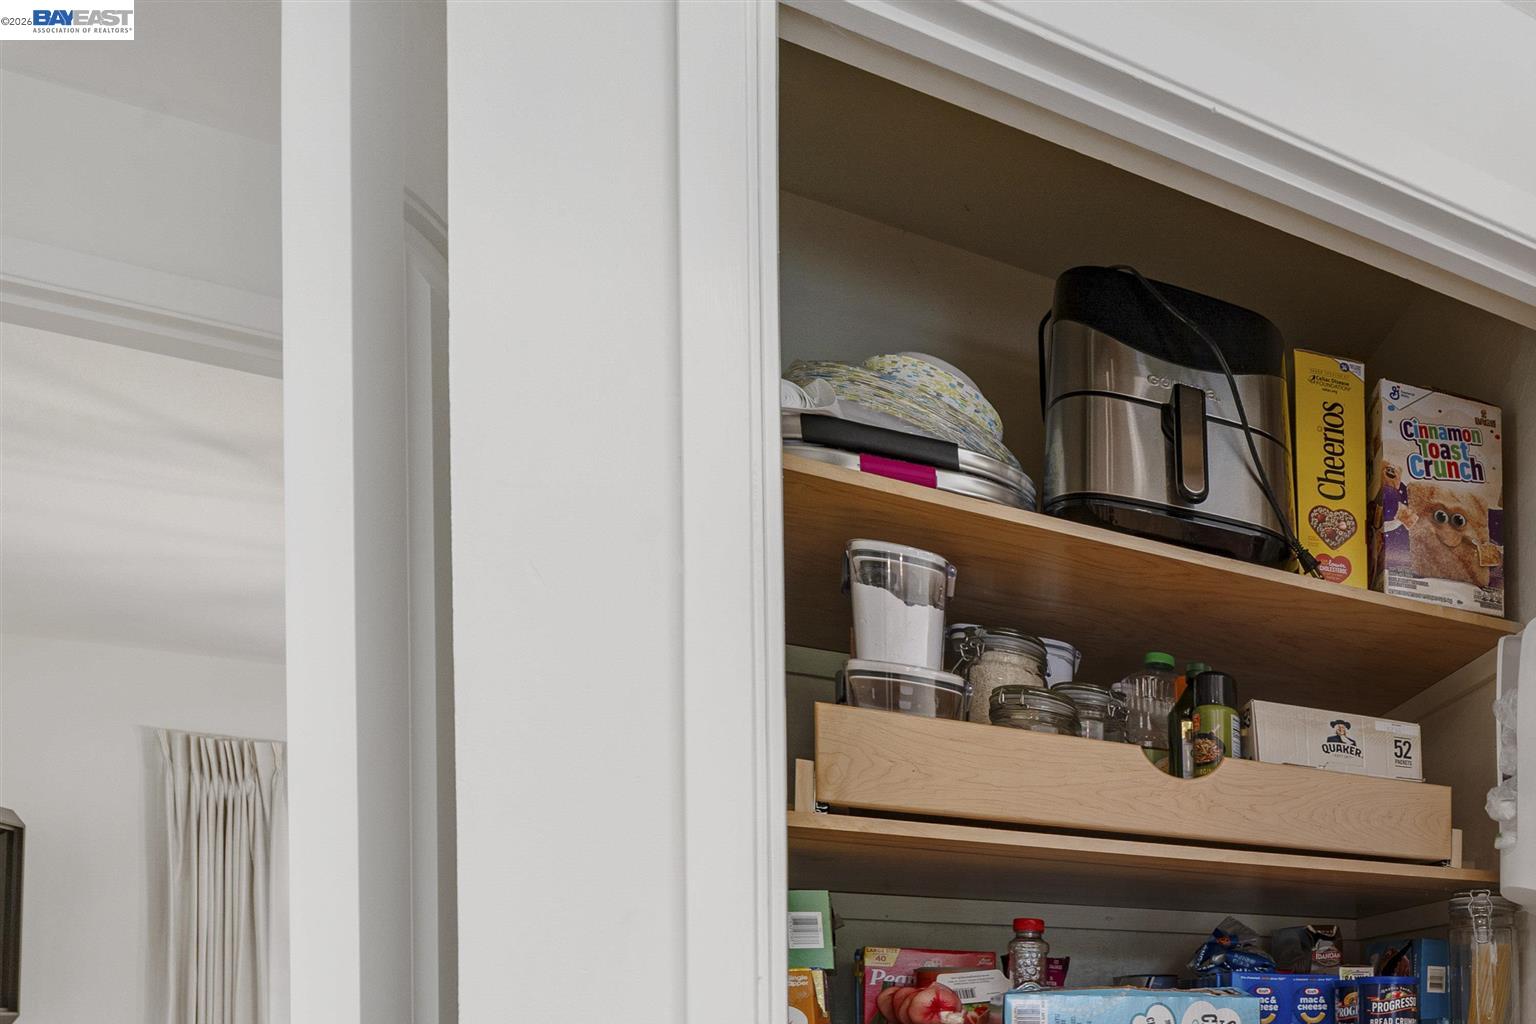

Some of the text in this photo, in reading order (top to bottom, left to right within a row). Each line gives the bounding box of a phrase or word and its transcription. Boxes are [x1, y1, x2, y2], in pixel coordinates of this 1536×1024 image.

[1403, 418, 1481, 444] Cinnamon
[1317, 401, 1347, 500] Cheerios
[1420, 442, 1469, 461] Toast
[1409, 456, 1484, 481] Crunch
[1322, 743, 1362, 758] QUAKER
[1394, 740, 1412, 759] 52
[875, 954, 887, 962] 40
[1371, 996, 1418, 1012] PROGRESSO
